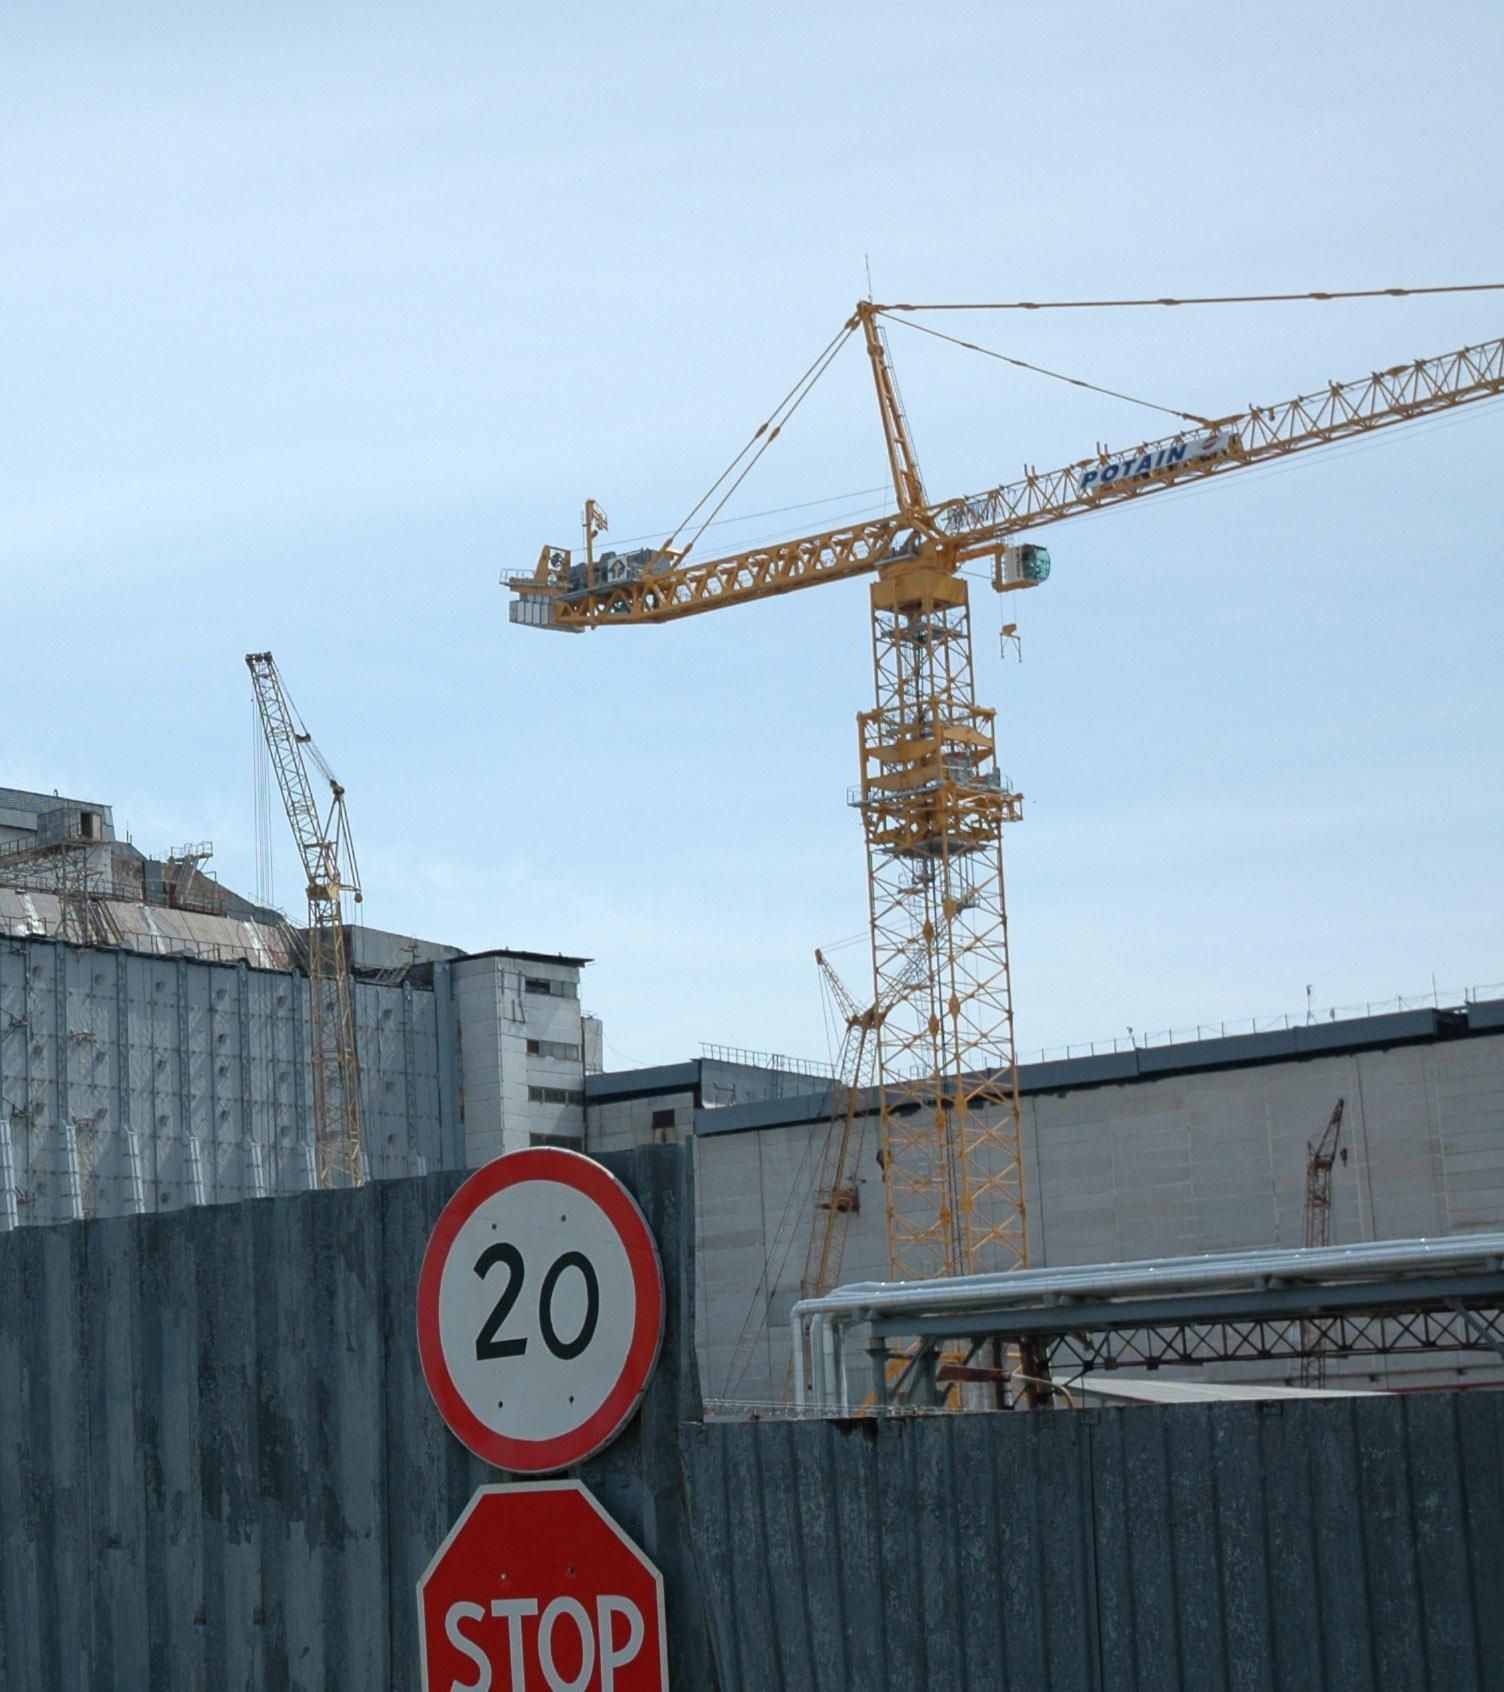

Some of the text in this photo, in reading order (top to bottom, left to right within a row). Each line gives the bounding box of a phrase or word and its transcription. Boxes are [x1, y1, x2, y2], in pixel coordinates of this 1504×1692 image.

[1080, 443, 1188, 489] POTAIN
[473, 1242, 600, 1361] 20
[445, 1595, 645, 1692] STOP
